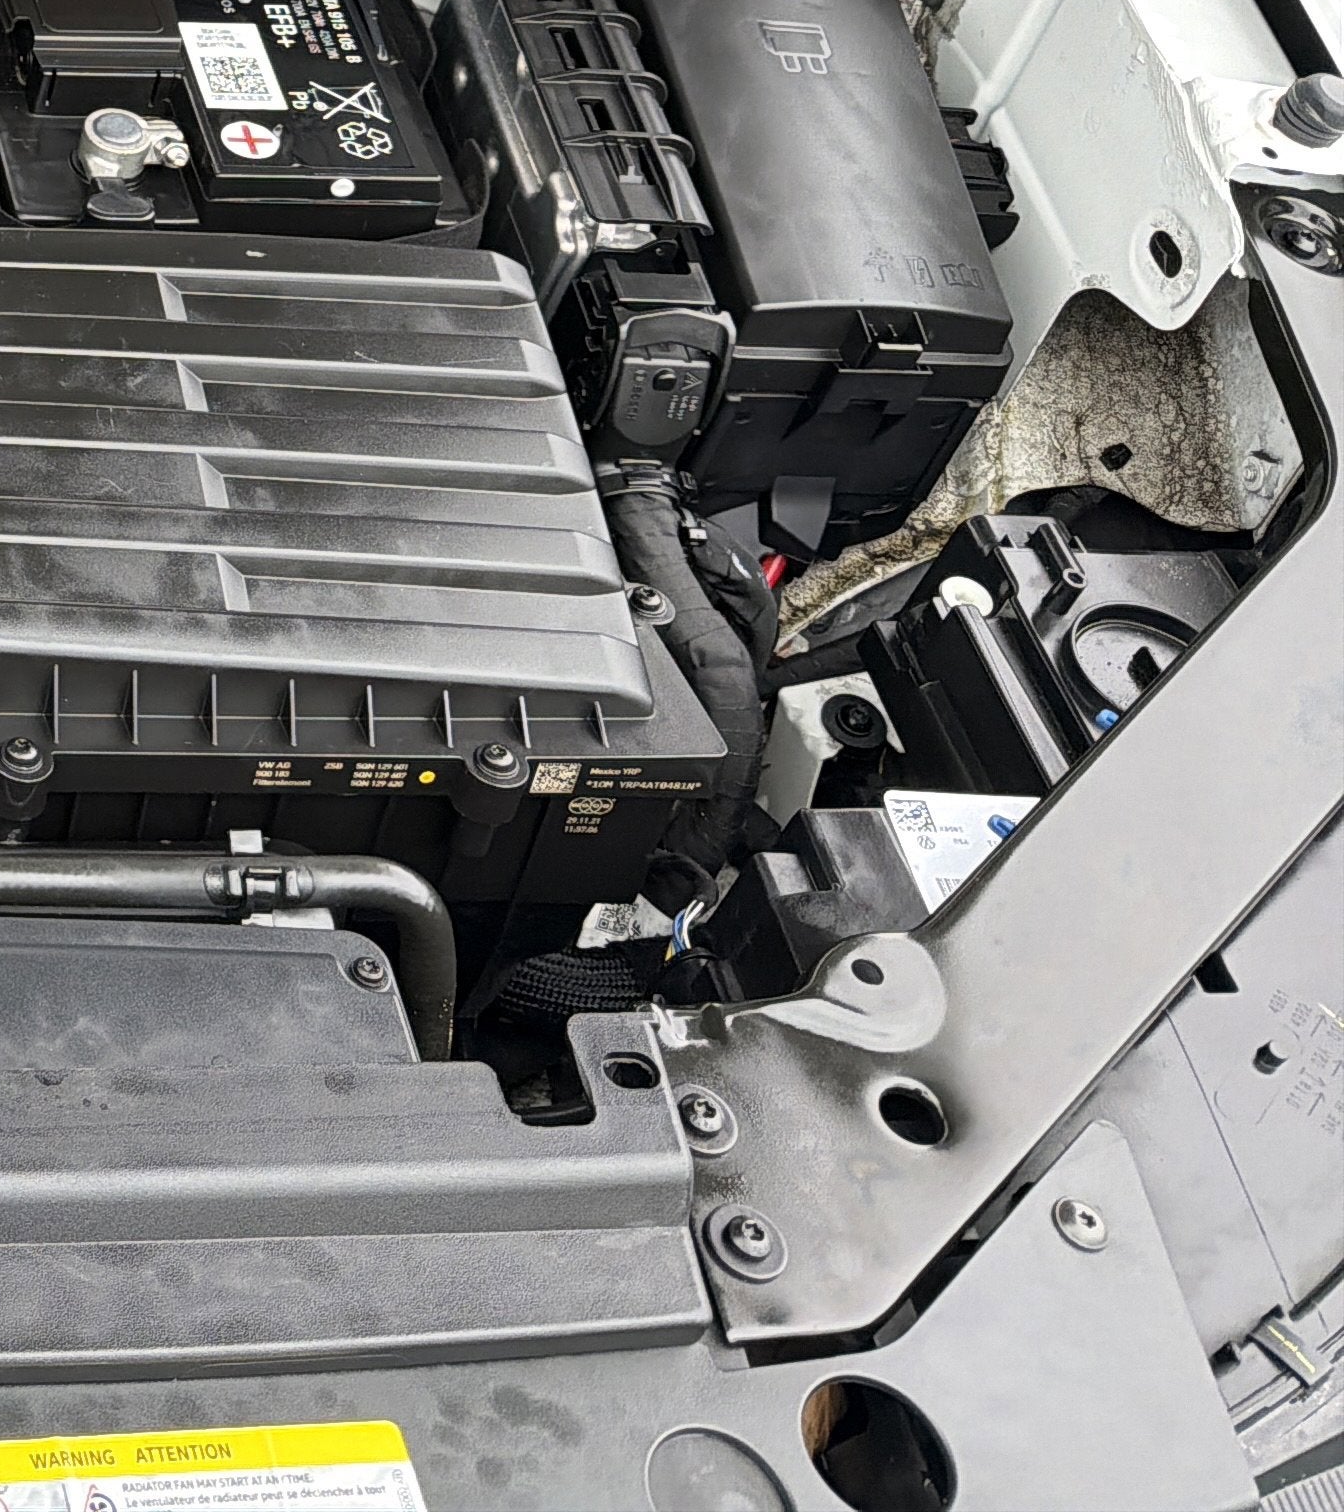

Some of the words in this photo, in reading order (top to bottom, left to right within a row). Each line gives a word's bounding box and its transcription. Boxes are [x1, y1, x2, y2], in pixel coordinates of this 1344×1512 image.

[263, 4, 298, 48] EFB+
[328, 11, 348, 30] 915
[337, 33, 358, 51] 105
[288, 91, 310, 110] Pb
[258, 761, 275, 769] VW
[589, 767, 621, 776] Mexico
[623, 767, 642, 776] YRP
[28, 1448, 116, 1469] WARNING
[135, 1442, 232, 1464] ATTENTION
[121, 1479, 173, 1493] RADIATOR
[174, 1479, 195, 1490] FAN
[196, 1477, 217, 1489] MAY
[218, 1476, 249, 1488] START
[251, 1475, 263, 1486] AT
[125, 1497, 138, 1509] Le
[140, 1494, 196, 1507] ventilateur
[197, 1493, 211, 1504] de
[212, 1491, 259, 1503] radiateur
[260, 1491, 284, 1504] peut
[286, 1491, 298, 1500] se
